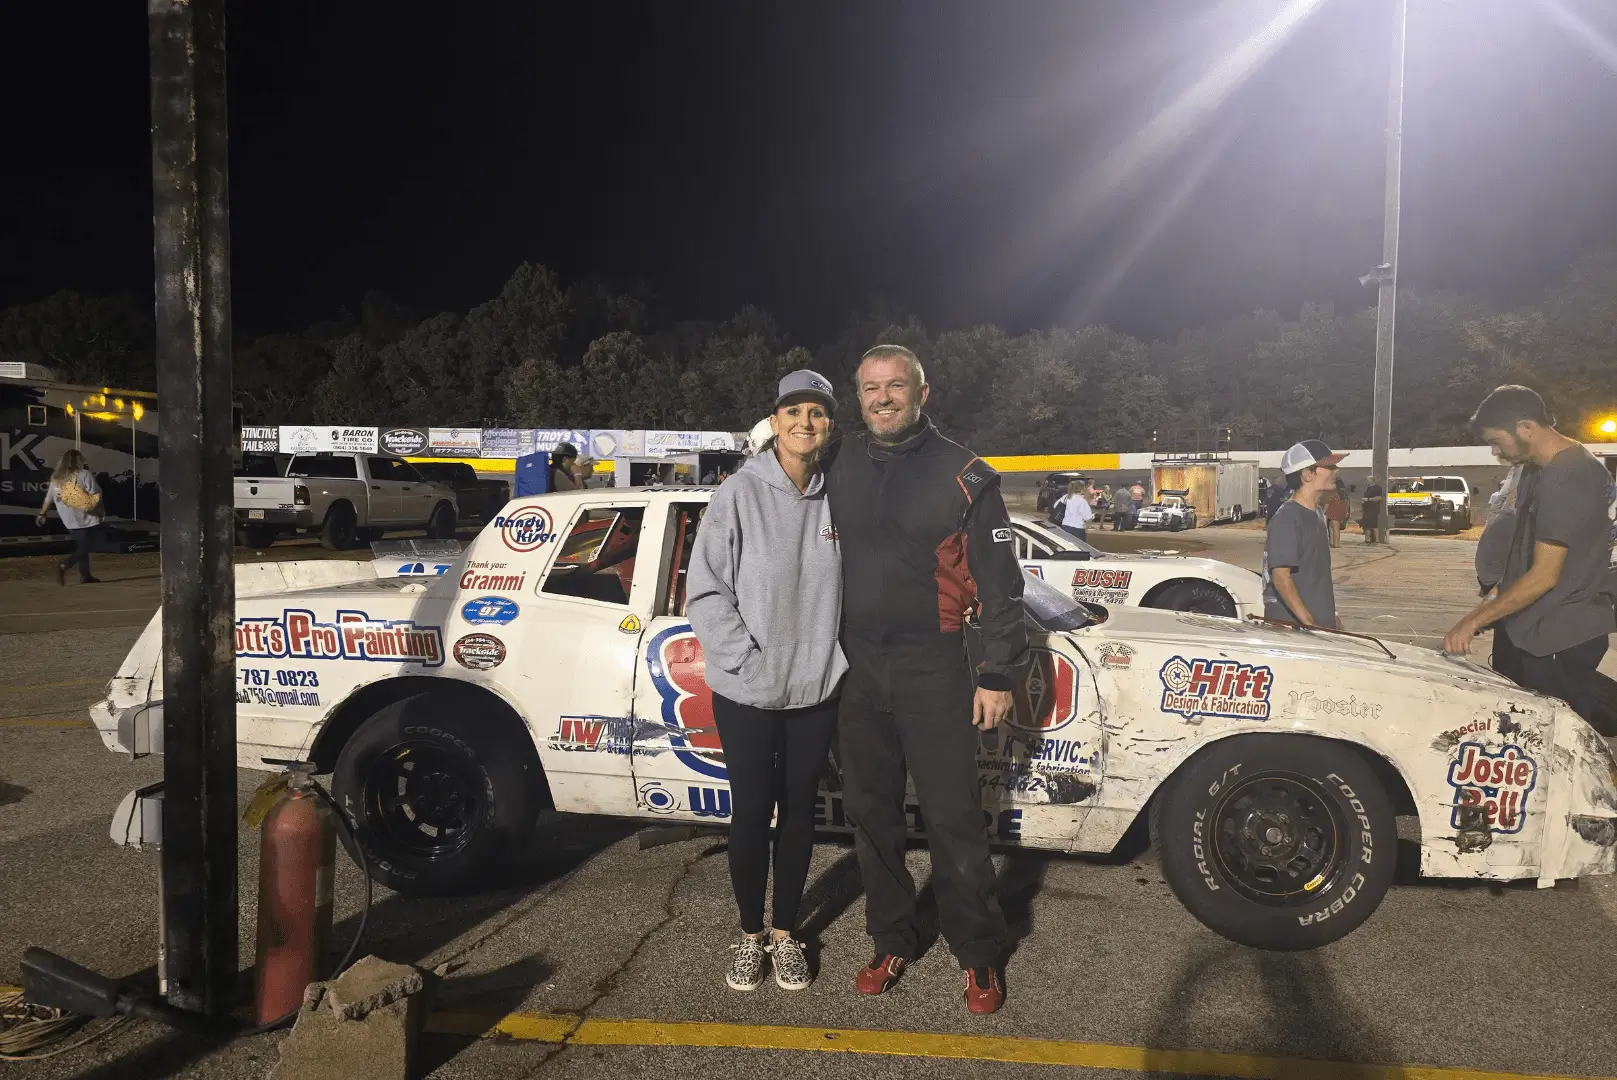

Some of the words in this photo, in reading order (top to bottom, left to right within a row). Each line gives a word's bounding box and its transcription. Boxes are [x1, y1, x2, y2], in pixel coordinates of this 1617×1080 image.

[342, 429, 375, 437] BARON
[384, 433, 424, 444] Trackside
[483, 429, 517, 438] Affordable
[494, 516, 545, 531] Randy
[515, 528, 556, 544] Kiser
[467, 560, 490, 569] Thank
[490, 561, 507, 571] you:
[459, 570, 526, 590] Grammi
[1072, 569, 1132, 589] BUSH
[478, 606, 502, 617] 97
[289, 615, 337, 653] Pro
[342, 615, 439, 661] Painting
[459, 645, 500, 656] Trackside
[236, 668, 319, 687] -787-0823
[1187, 662, 1269, 698] Hitt
[1165, 693, 1200, 716] Design
[1201, 699, 1209, 711] &
[1210, 700, 1268, 717] Fabrication
[1281, 690, 1383, 720] Hoosier
[1443, 718, 1492, 742] pecial
[1036, 761, 1090, 775] fabrication
[1456, 749, 1530, 786] Josie
[1326, 772, 1373, 865] COOPER
[1192, 807, 1221, 891] RADIAL
[1298, 872, 1366, 926] COBRA
